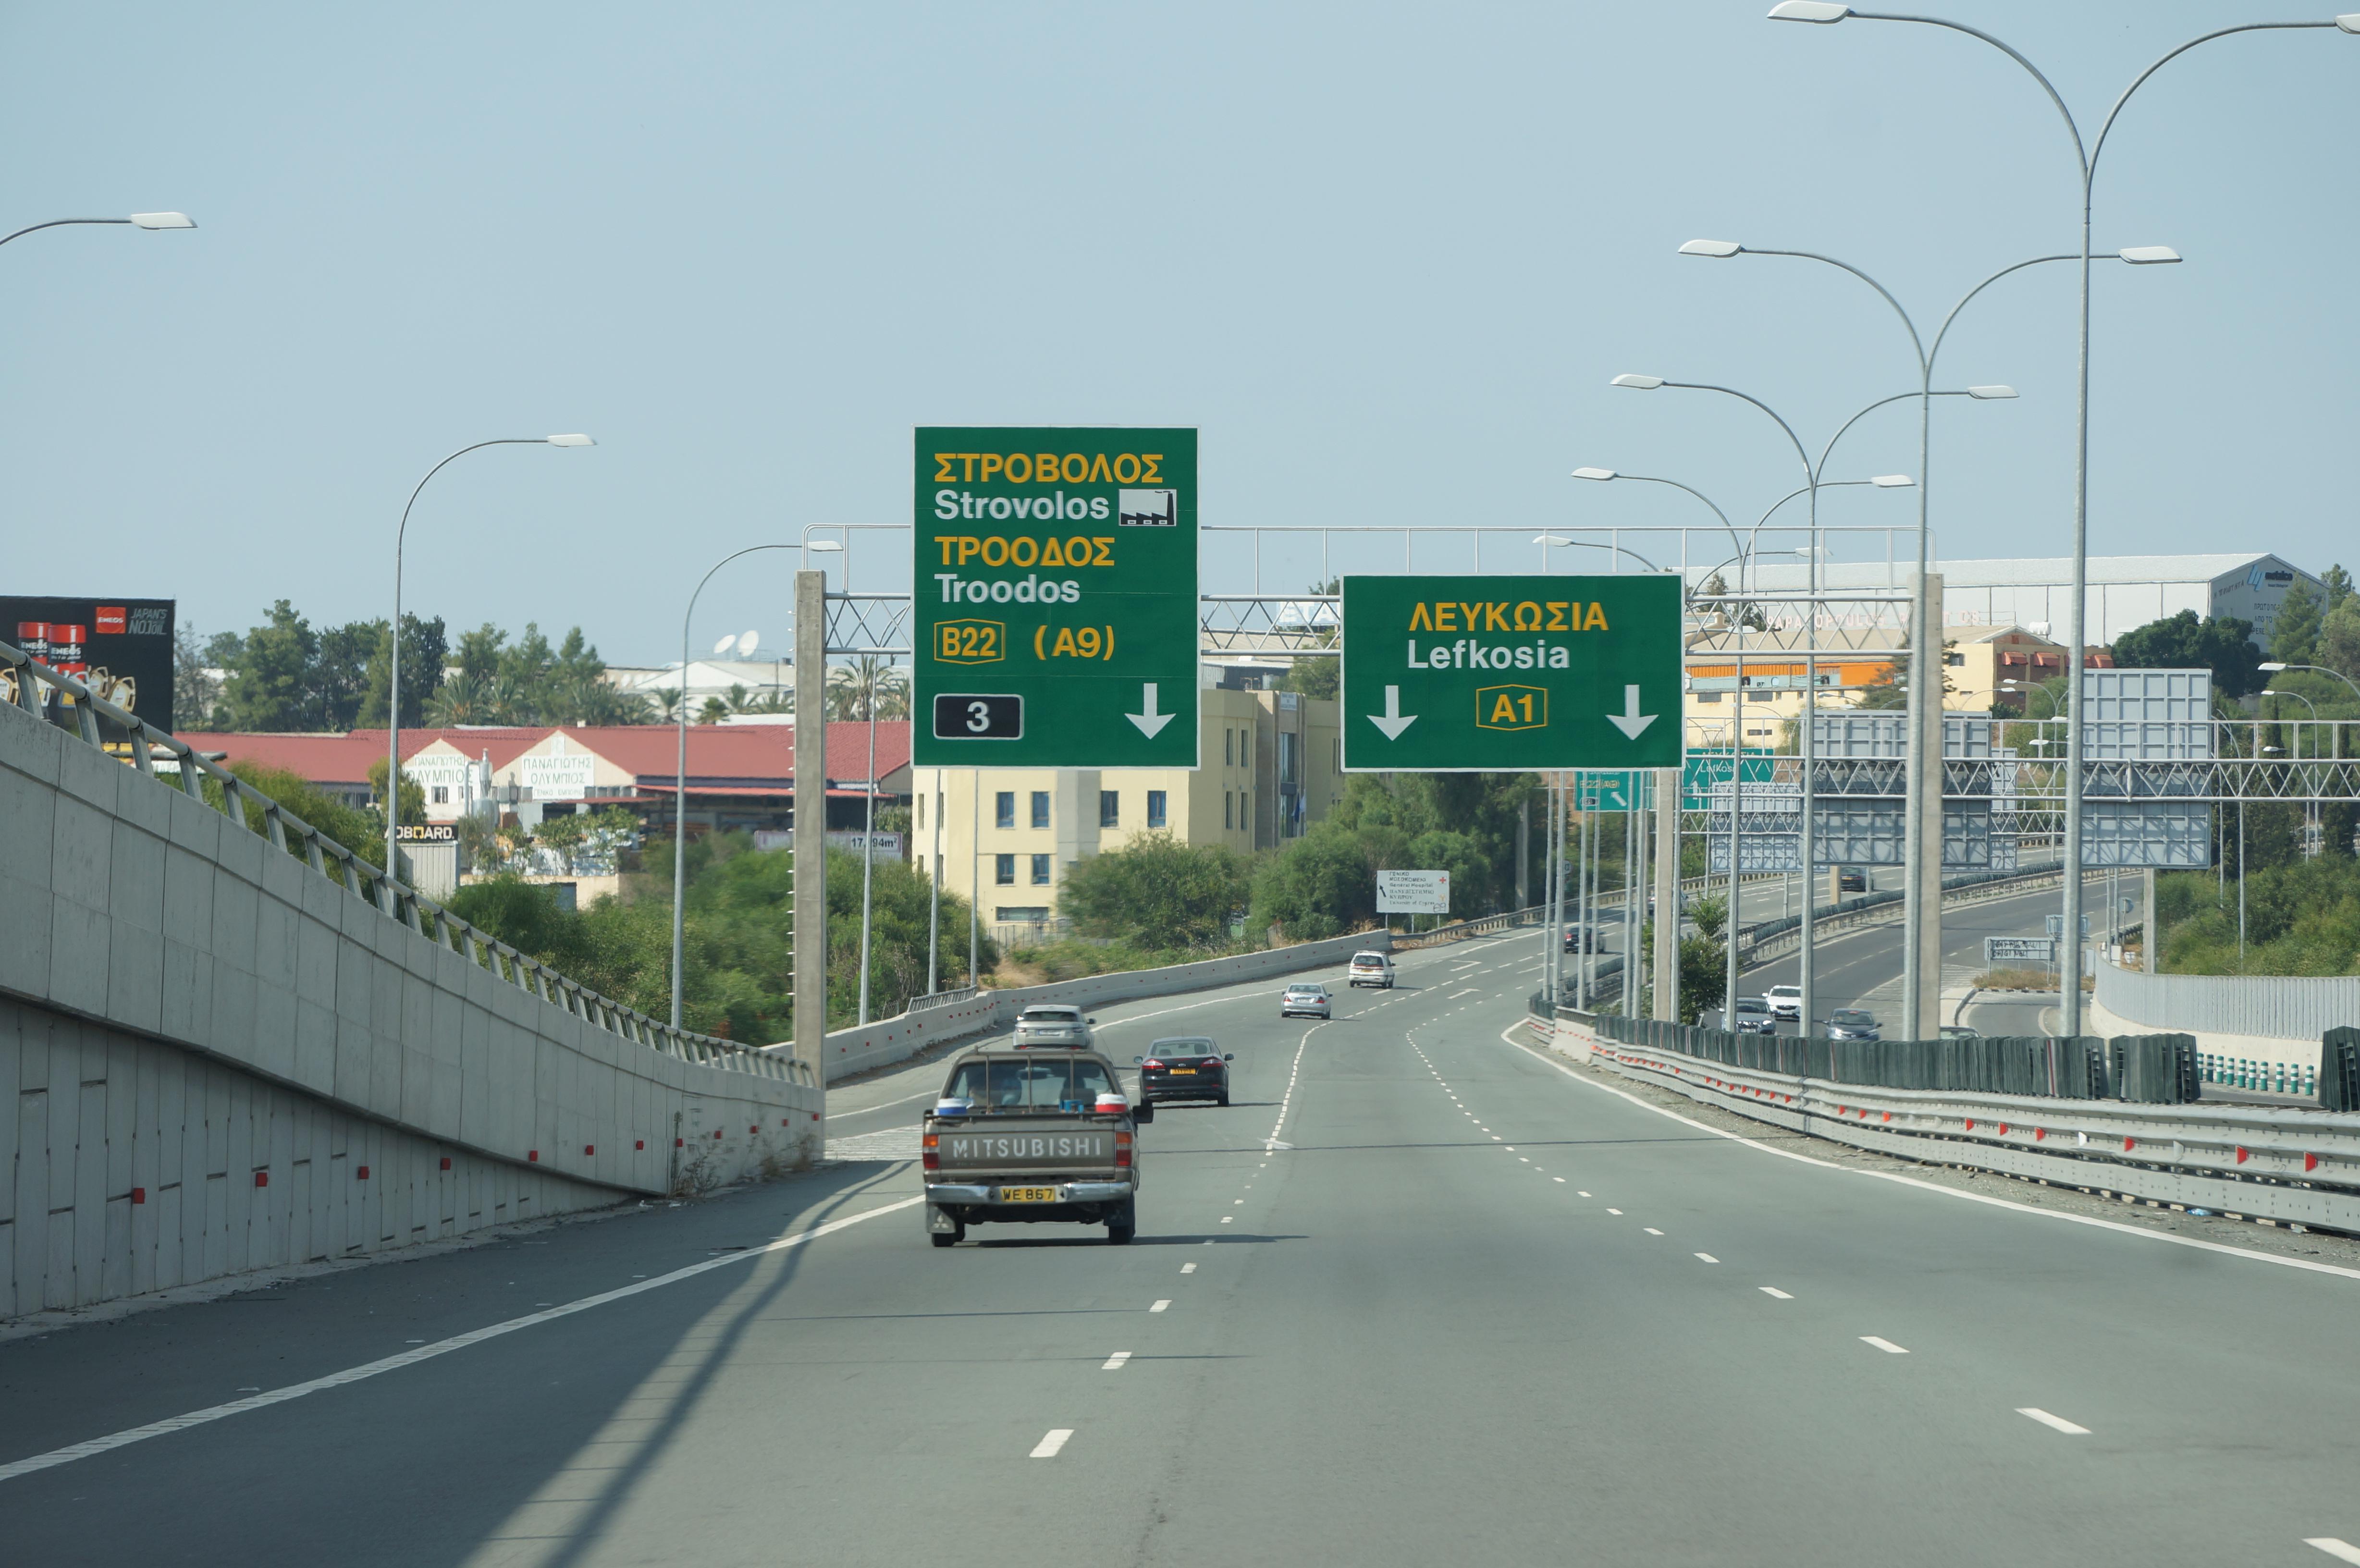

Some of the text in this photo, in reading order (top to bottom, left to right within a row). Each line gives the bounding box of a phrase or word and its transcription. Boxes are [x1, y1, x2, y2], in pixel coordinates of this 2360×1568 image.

[934, 453, 1163, 483] ΣΤΡΟΒΟΛΟΣ
[934, 490, 1110, 520] Strovolos
[934, 536, 1115, 567] ΤΡΟΟΔΟΣ
[934, 574, 1081, 603] Troodos
[1409, 601, 1609, 631] ΛΕΥΚΩΣΙΑ
[50, 647, 81, 655] ENEOS
[942, 625, 1115, 661] B22 (A9)
[1408, 639, 1570, 669] Lefkosia
[967, 701, 991, 733] 3
[1490, 694, 1533, 723] A1
[415, 756, 463, 766] ΠΑΝΑΓΙΩΤΗΣ
[523, 757, 591, 770] ΠΑΝΑΓΙΩΤΗΣ
[531, 772, 585, 785] ΟΛΥΜΠΙΟΣ
[953, 1137, 1101, 1158] MITSUBISHI
[1003, 1188, 1053, 1200] WE 867
